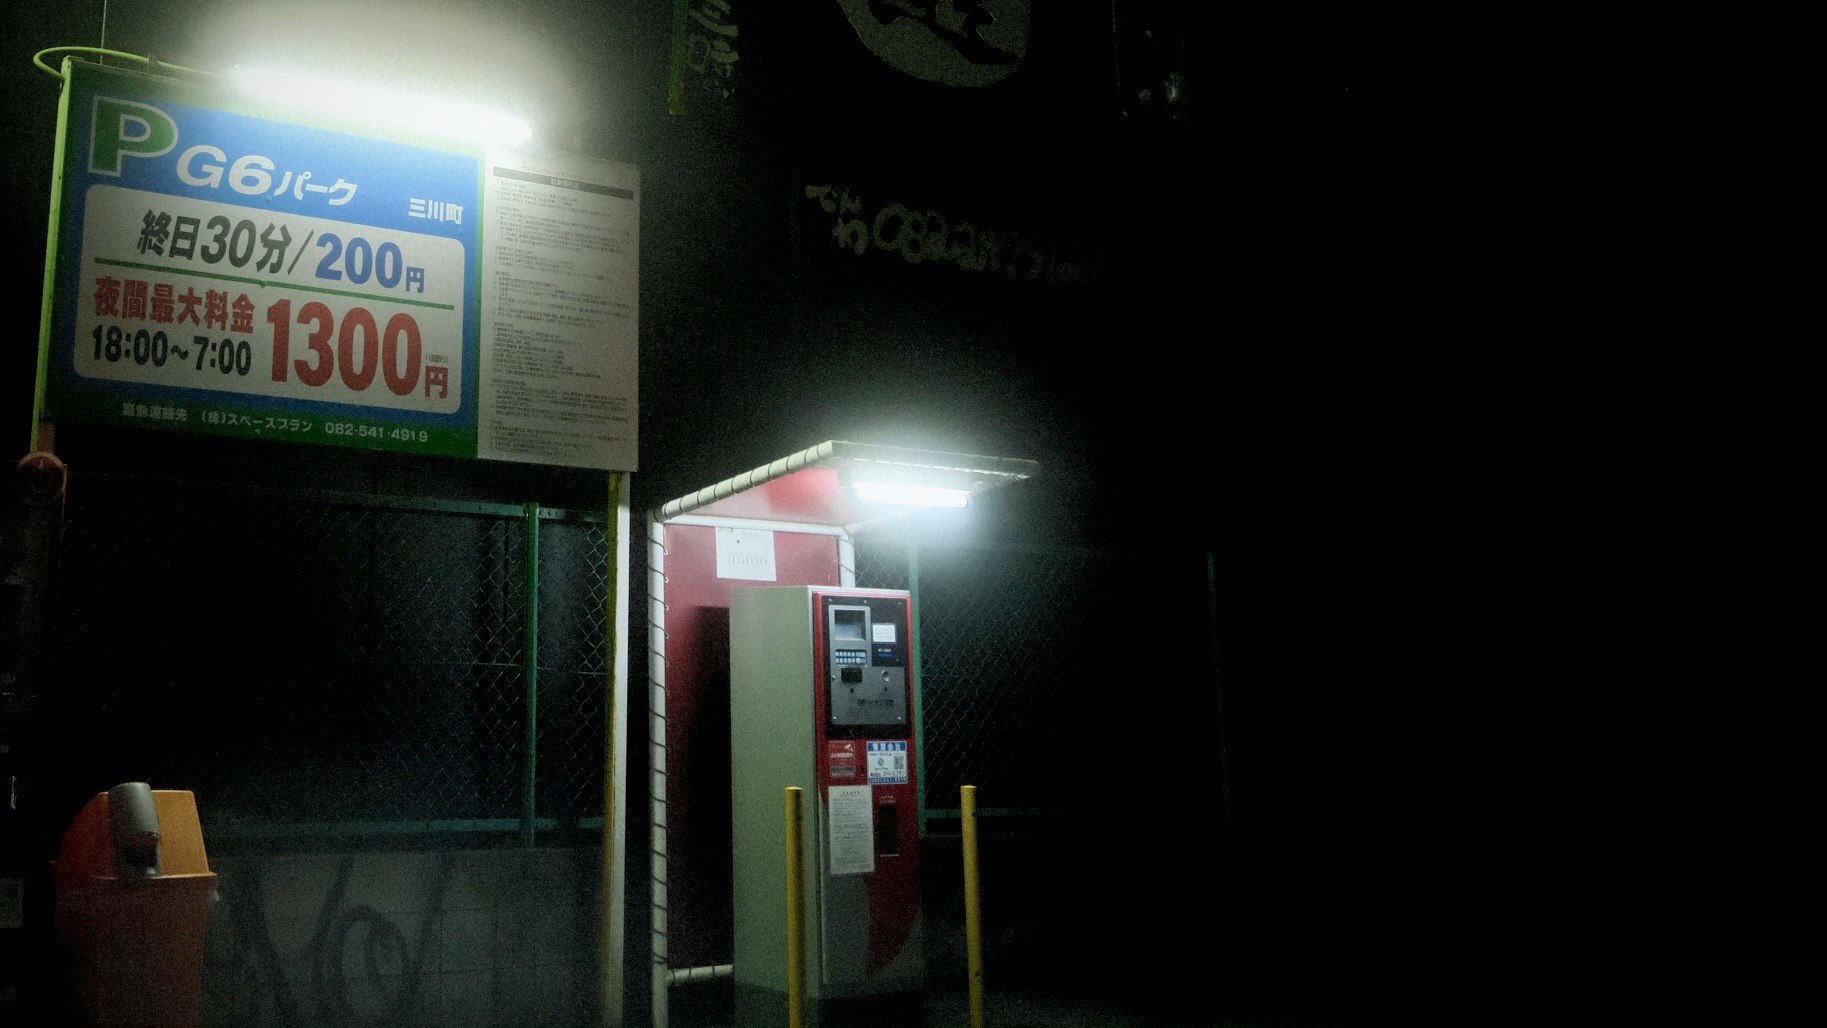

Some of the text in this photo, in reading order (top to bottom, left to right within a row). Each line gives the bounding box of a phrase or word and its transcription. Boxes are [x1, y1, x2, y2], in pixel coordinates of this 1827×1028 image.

[87, 94, 179, 177] P
[408, 197, 464, 225] 三川町
[93, 275, 255, 334] 夜間最大料金
[266, 298, 449, 400] 1300円
[325, 422, 429, 443] 082-541-4919
